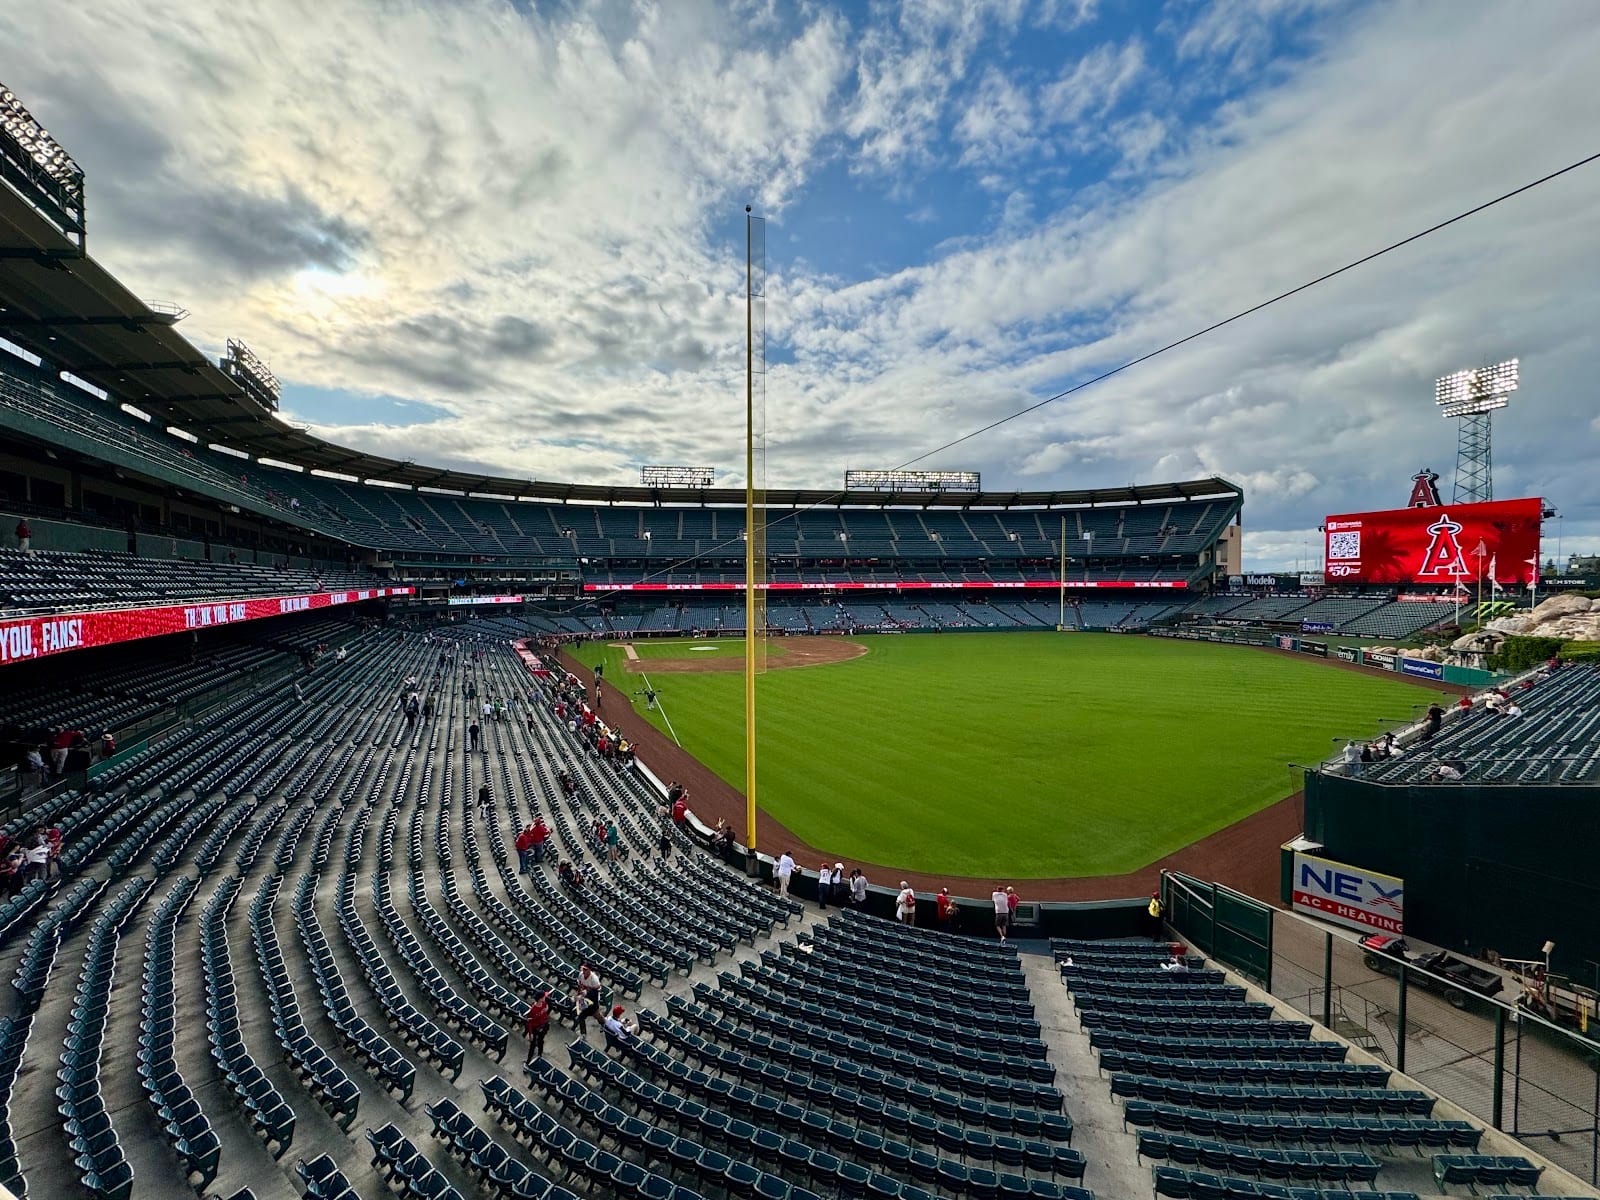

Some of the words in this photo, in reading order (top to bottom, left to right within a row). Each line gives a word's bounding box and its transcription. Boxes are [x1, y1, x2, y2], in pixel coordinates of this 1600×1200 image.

[1247, 576, 1275, 585] Modelo
[213, 604, 229, 624] YOU,
[230, 603, 246, 621] FANS!
[0, 625, 38, 661] YOU,
[42, 619, 84, 652] FANS!
[1300, 895, 1321, 907] AC
[1338, 905, 1404, 932] HEATING
